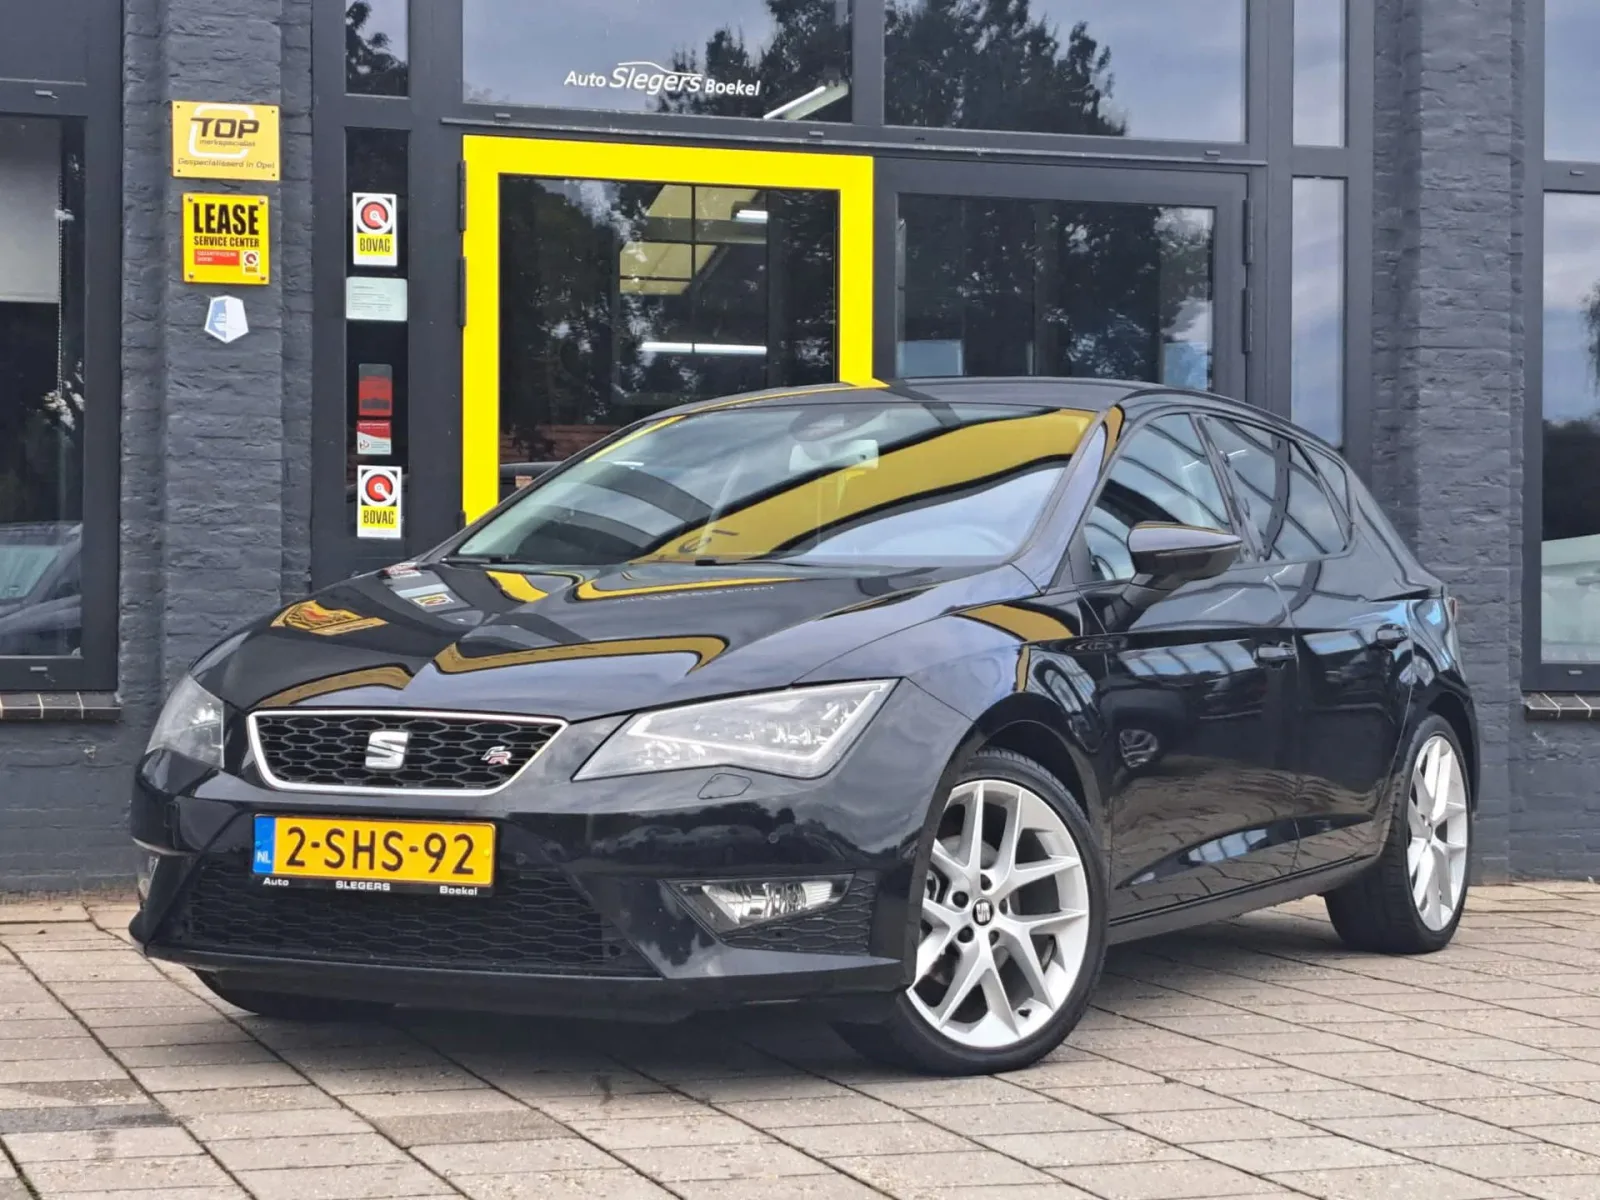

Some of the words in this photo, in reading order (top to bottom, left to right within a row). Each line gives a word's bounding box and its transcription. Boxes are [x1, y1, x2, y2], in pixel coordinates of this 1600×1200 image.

[563, 70, 607, 88] Auto
[609, 66, 702, 95] Slegers
[704, 79, 761, 97] Boekel
[190, 117, 260, 139] TOP
[246, 160, 255, 169] in
[193, 202, 260, 236] LEASE
[193, 235, 228, 247] SERVICE
[229, 236, 260, 248] CENTER
[359, 237, 391, 253] BOVAG
[363, 509, 395, 525] BOVAG
[256, 850, 272, 864] NL
[285, 825, 475, 876] 2-SHS-92
[262, 876, 290, 887] Auto
[335, 880, 391, 892] SLEGERS
[439, 885, 478, 896] Boekel
